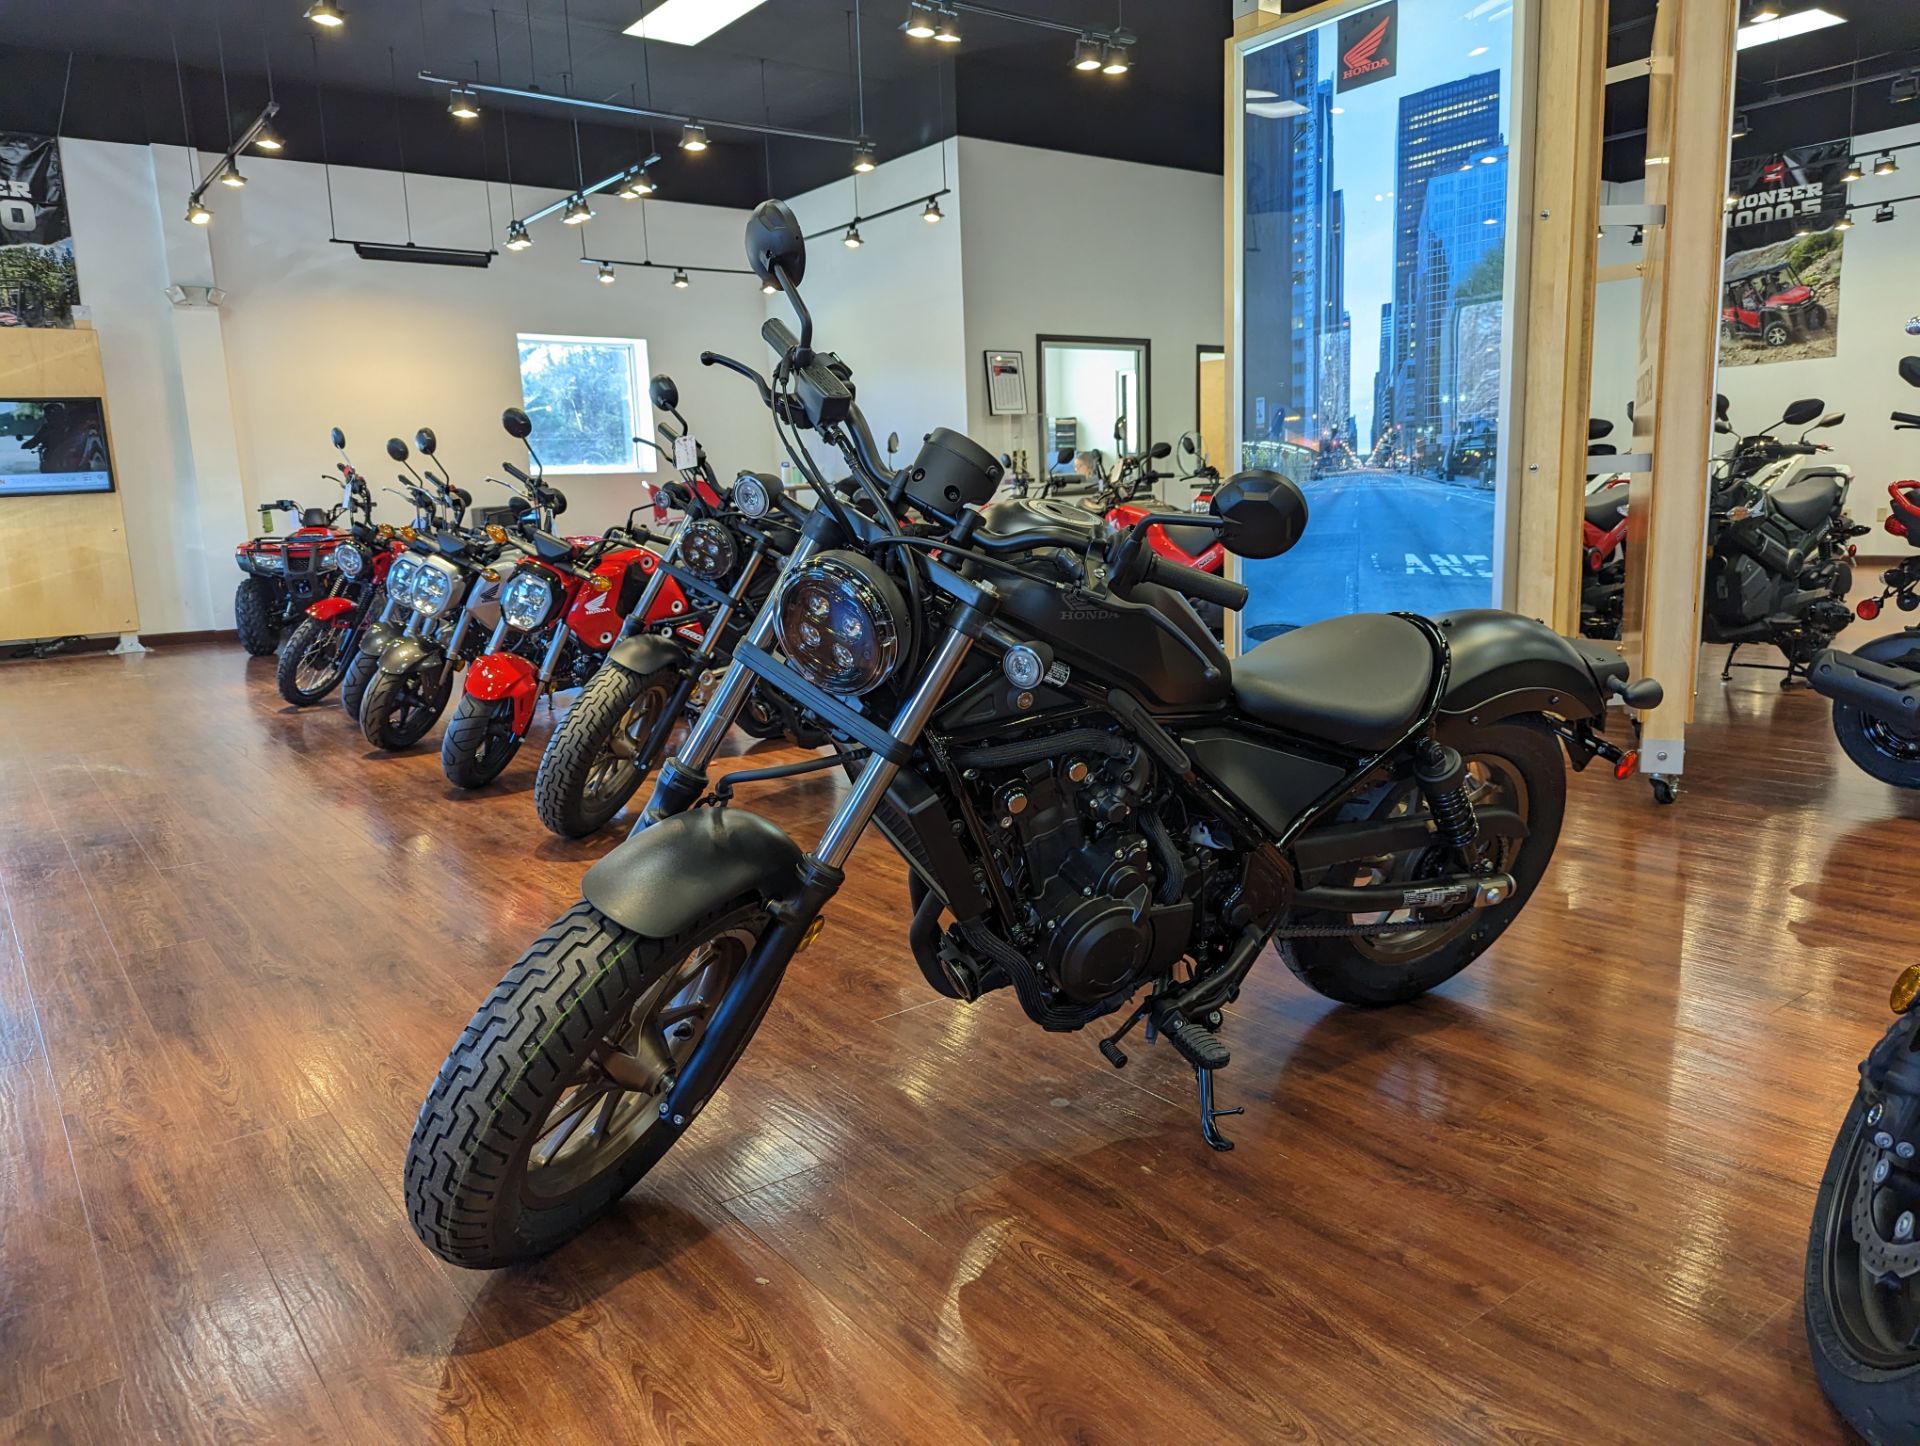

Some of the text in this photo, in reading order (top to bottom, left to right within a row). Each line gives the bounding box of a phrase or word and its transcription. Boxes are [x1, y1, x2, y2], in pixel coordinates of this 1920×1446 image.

[1343, 57, 1390, 80] HONDA
[1728, 182, 1823, 210] IONEER
[1371, 553, 1494, 578] ANE
[585, 607, 611, 616] HONDA
[1060, 610, 1120, 620] HONDA
[678, 628, 704, 642] GRO
